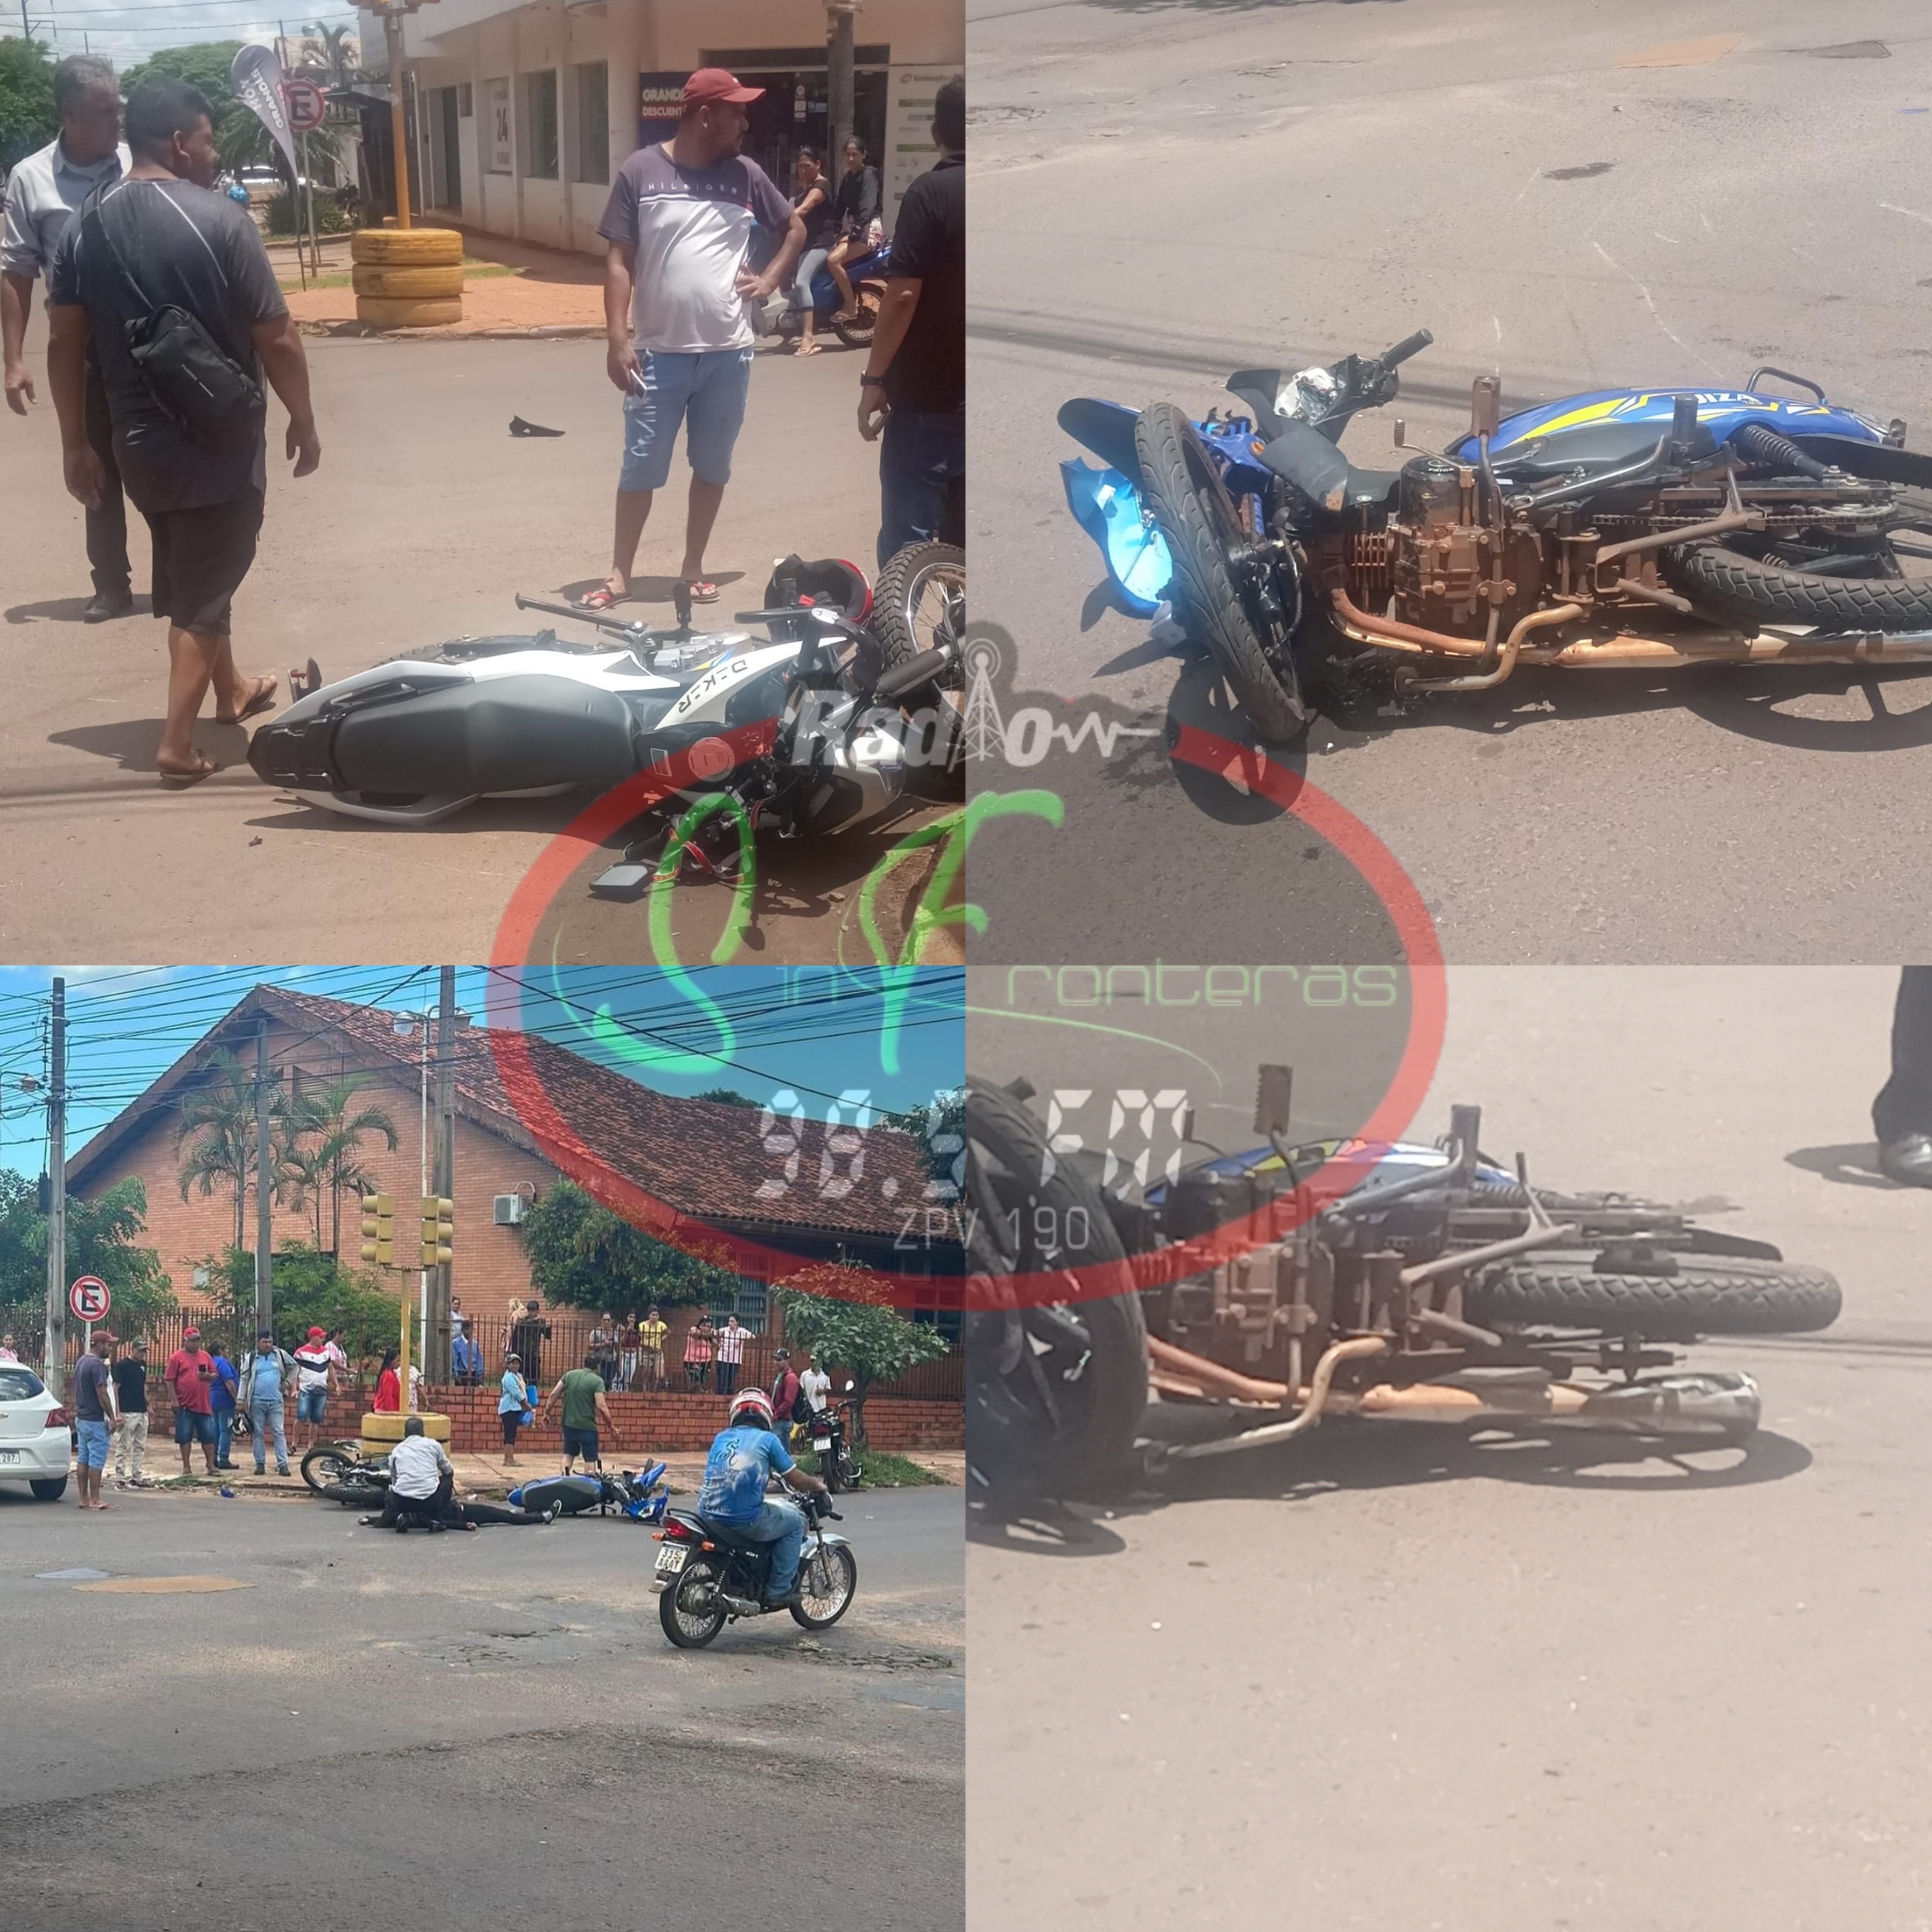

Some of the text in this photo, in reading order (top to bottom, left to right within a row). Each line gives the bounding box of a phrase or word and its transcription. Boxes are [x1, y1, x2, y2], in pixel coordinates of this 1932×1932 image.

[642, 88, 684, 102] GRAND
[648, 183, 737, 194] HILFIGER
[82, 1285, 100, 1312] E
